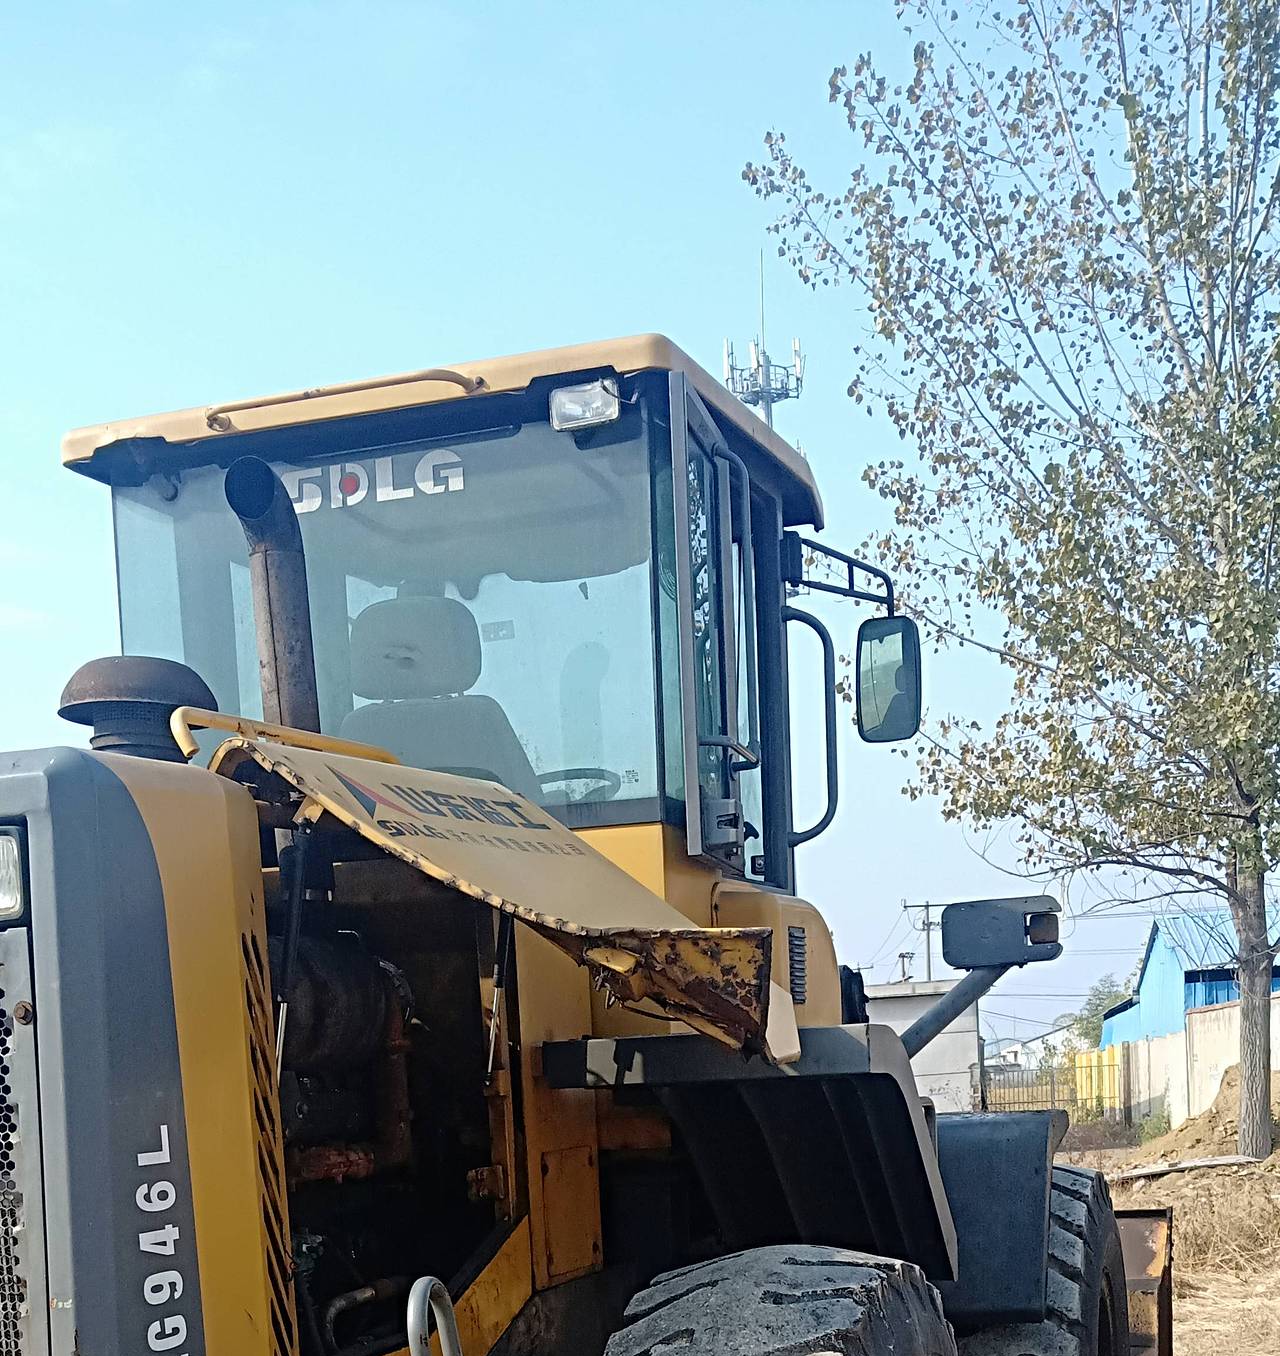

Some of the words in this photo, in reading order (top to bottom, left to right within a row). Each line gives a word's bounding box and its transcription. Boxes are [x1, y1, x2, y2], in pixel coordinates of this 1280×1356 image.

[281, 449, 465, 514] SDLG
[376, 819, 449, 838] SDLG
[380, 782, 552, 831] 山东临工
